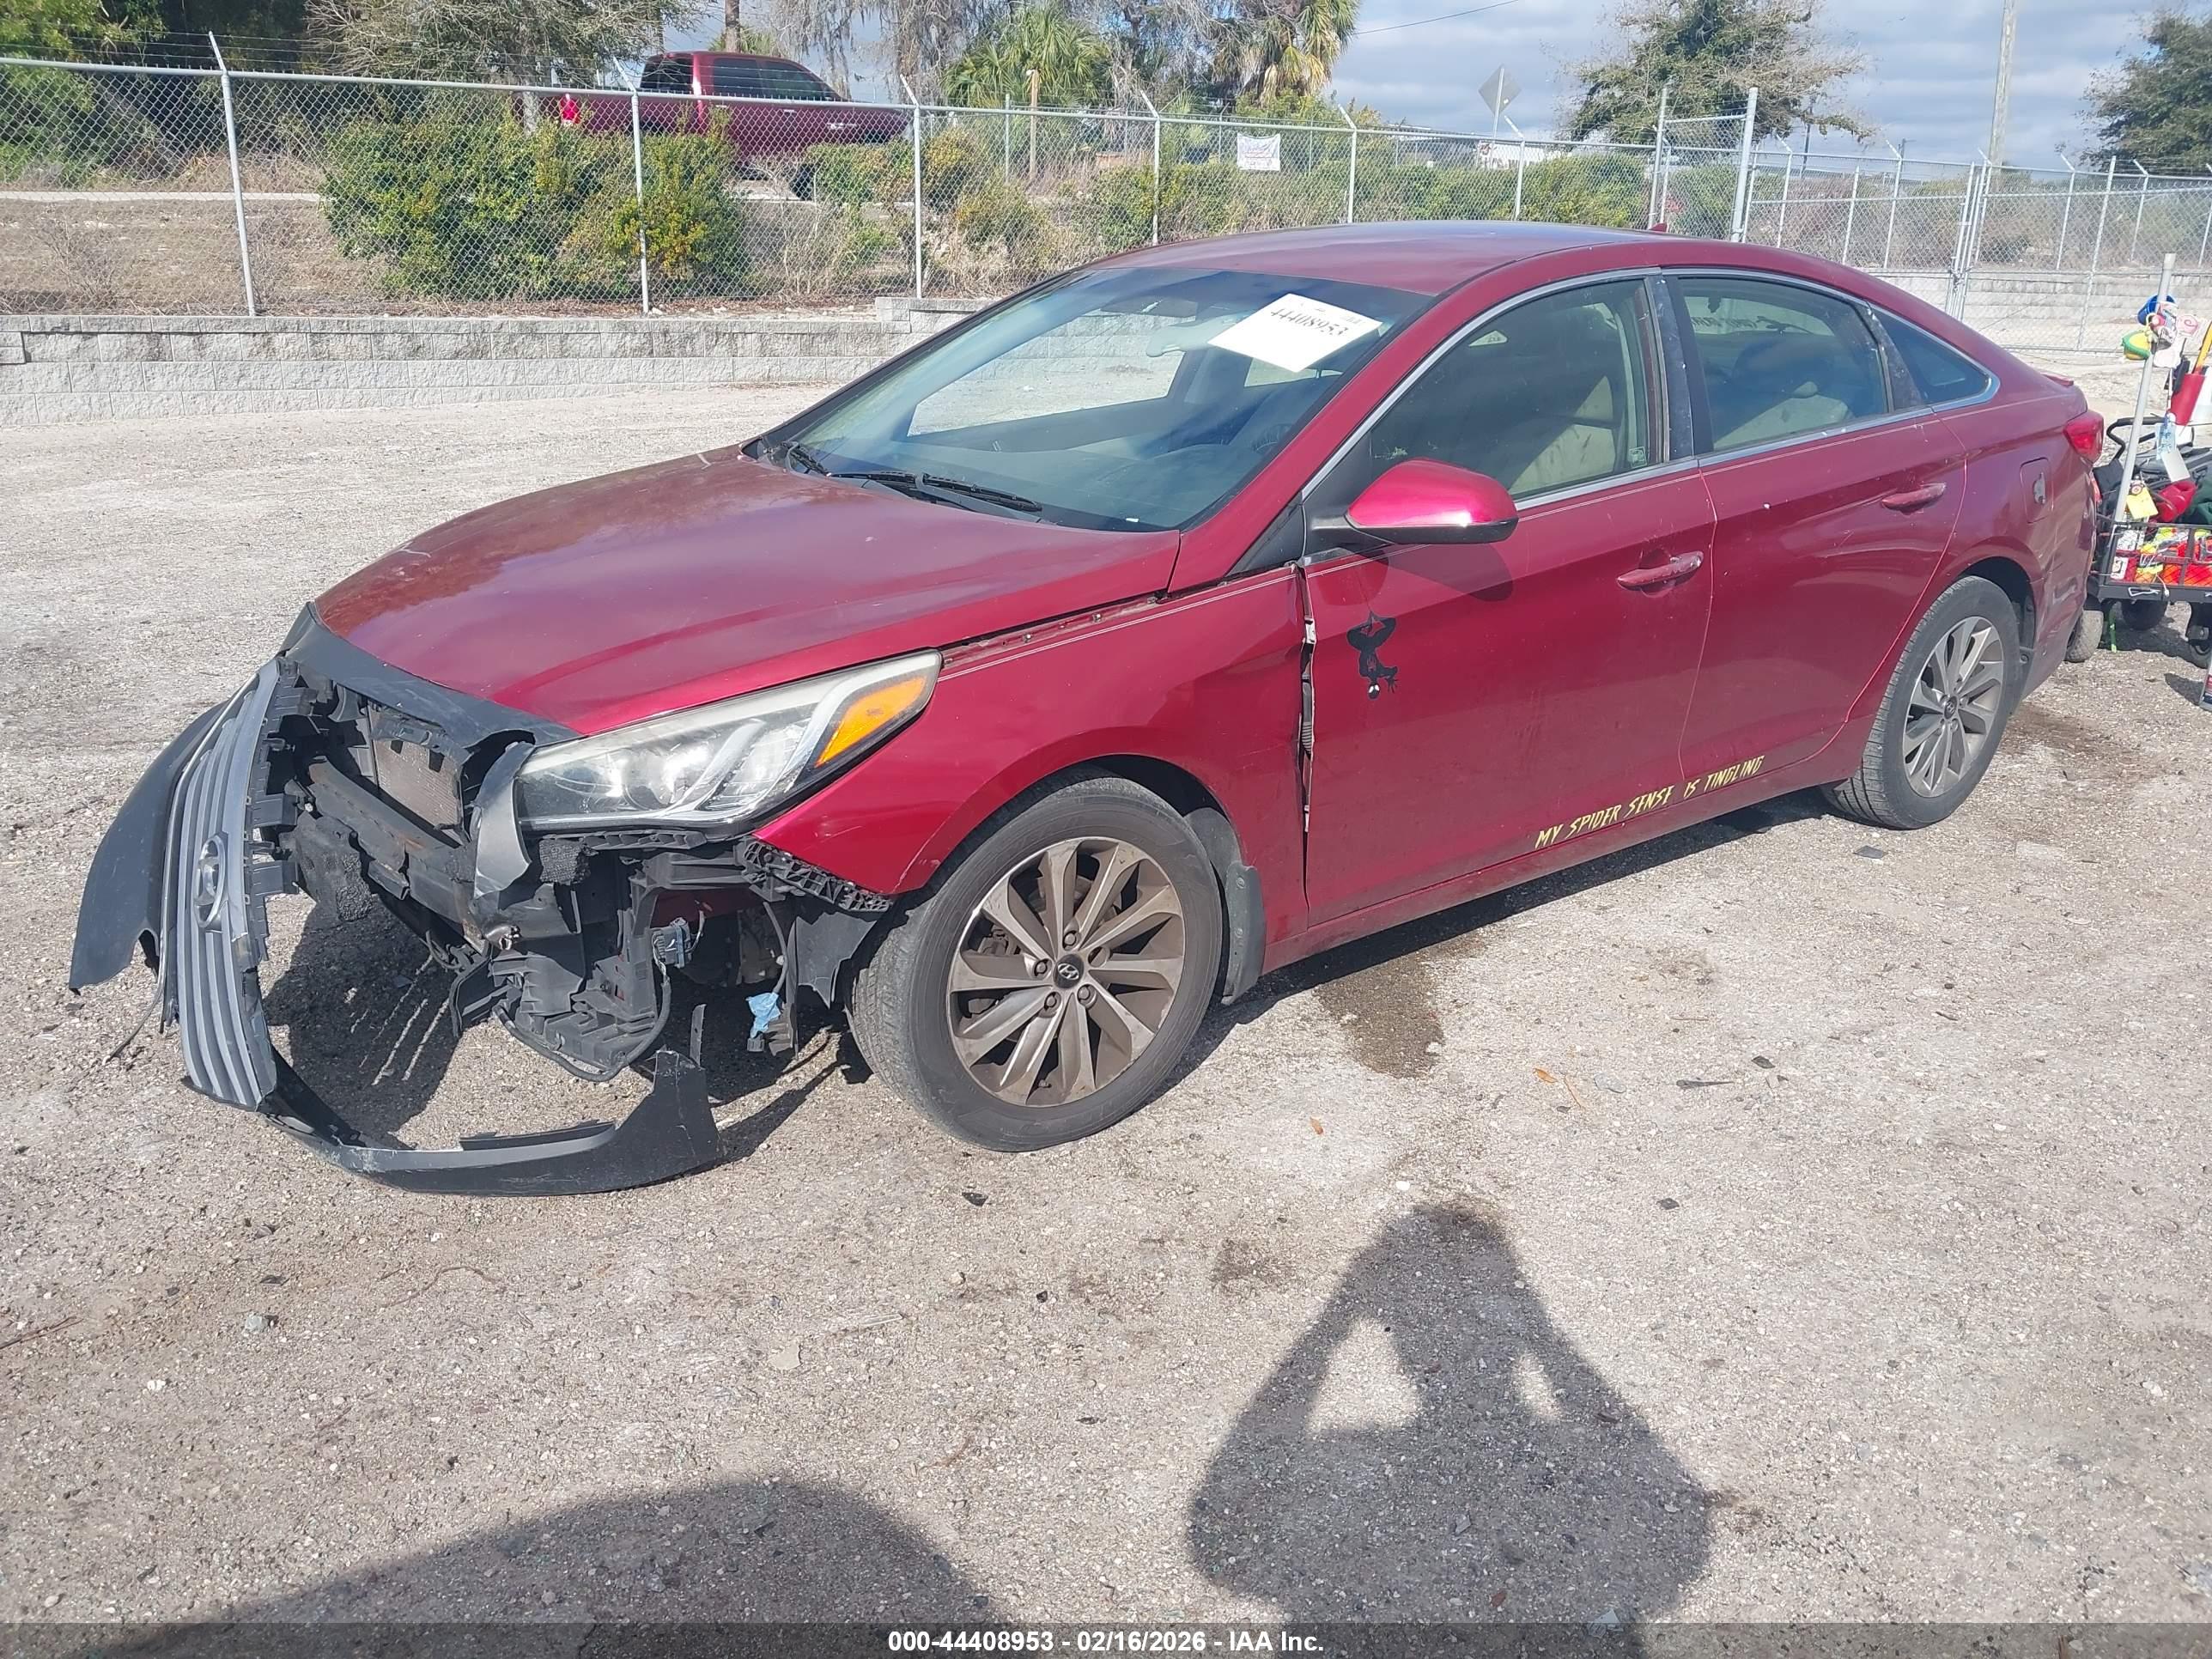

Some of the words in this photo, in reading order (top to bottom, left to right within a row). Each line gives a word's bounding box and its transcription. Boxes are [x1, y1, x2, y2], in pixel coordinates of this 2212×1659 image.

[1270, 308, 1349, 337] 44408953
[1534, 824, 1564, 848] MY
[1565, 805, 1622, 839] SPIDER
[1625, 786, 1674, 818] SENSE
[1683, 779, 1702, 799] IS
[1704, 756, 1765, 792] TINGLING
